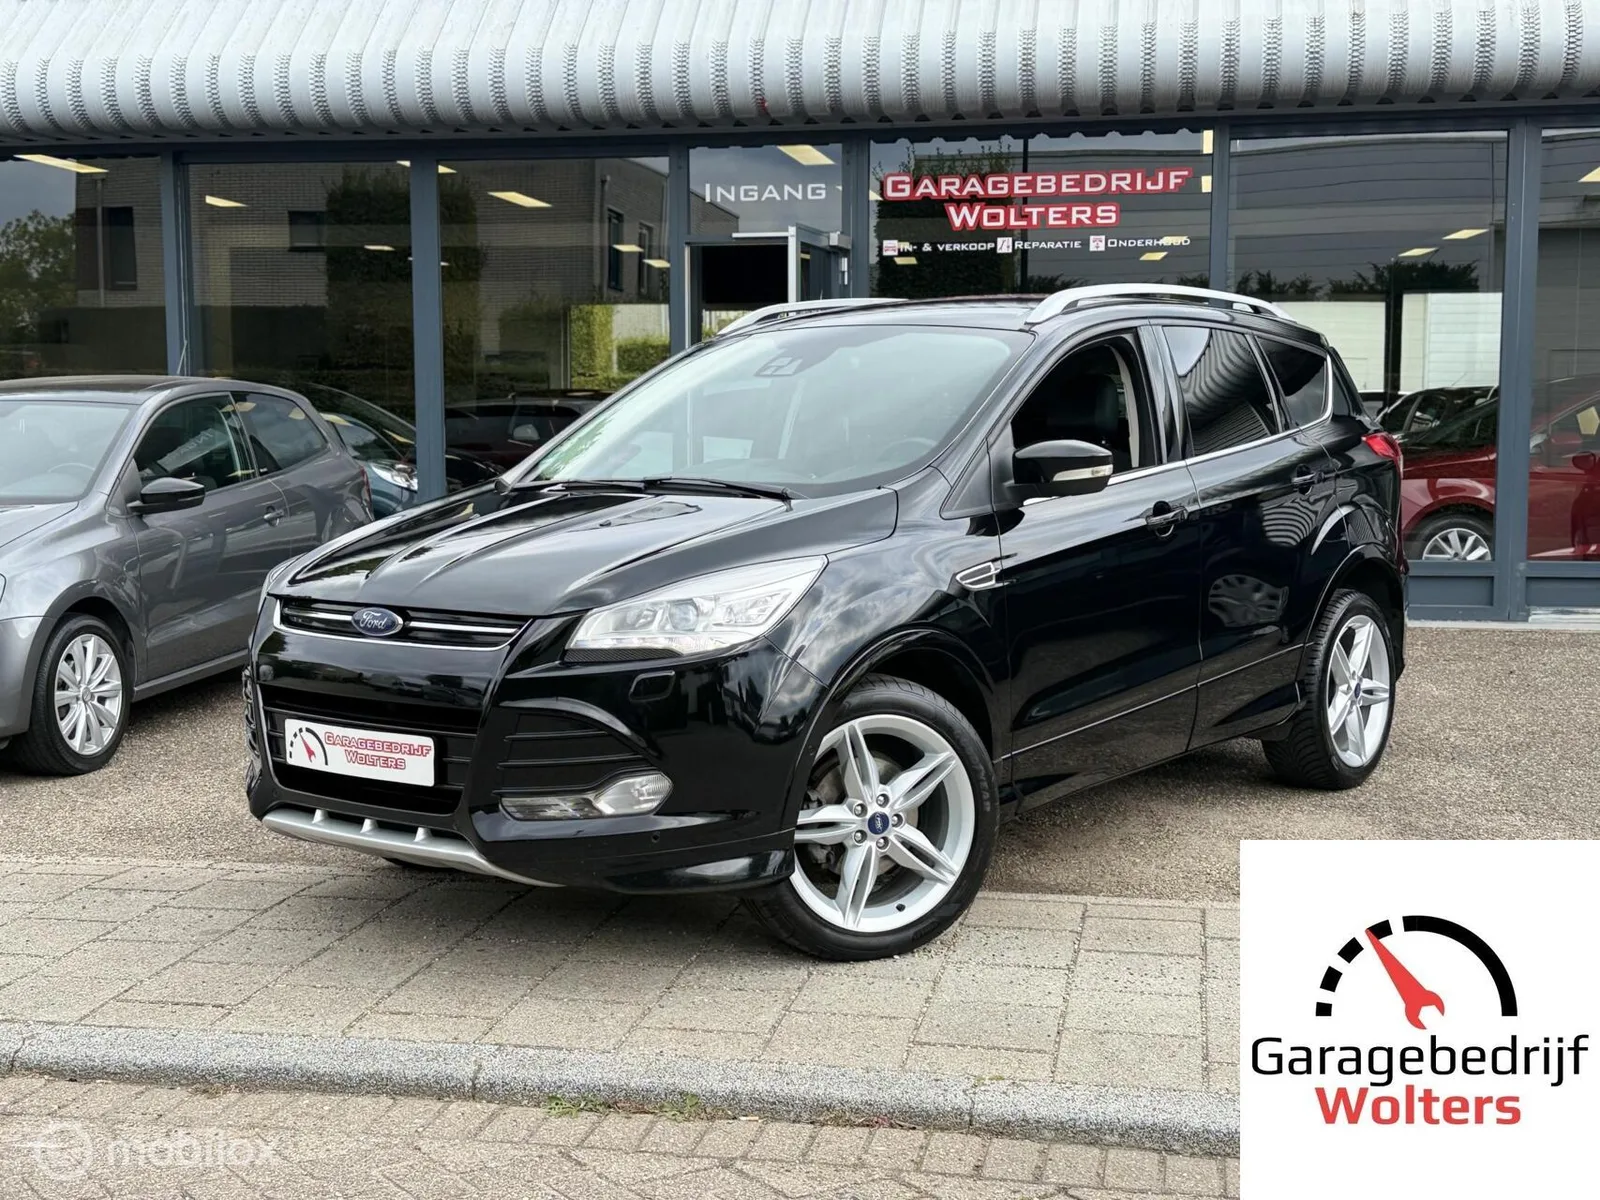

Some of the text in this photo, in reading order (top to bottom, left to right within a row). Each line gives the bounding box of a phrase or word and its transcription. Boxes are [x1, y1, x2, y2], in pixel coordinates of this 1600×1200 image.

[705, 183, 826, 203] INGANG
[884, 169, 1192, 199] GARAGEBEDRIJF
[946, 203, 1119, 229] WOLTERS
[922, 243, 932, 251] &
[937, 242, 995, 251] VERKOOP
[1014, 240, 1082, 250] REPARATIE
[360, 611, 388, 630] Ford
[324, 731, 432, 757] GARAGEBEDRIJF
[345, 750, 406, 770] WOLTERS
